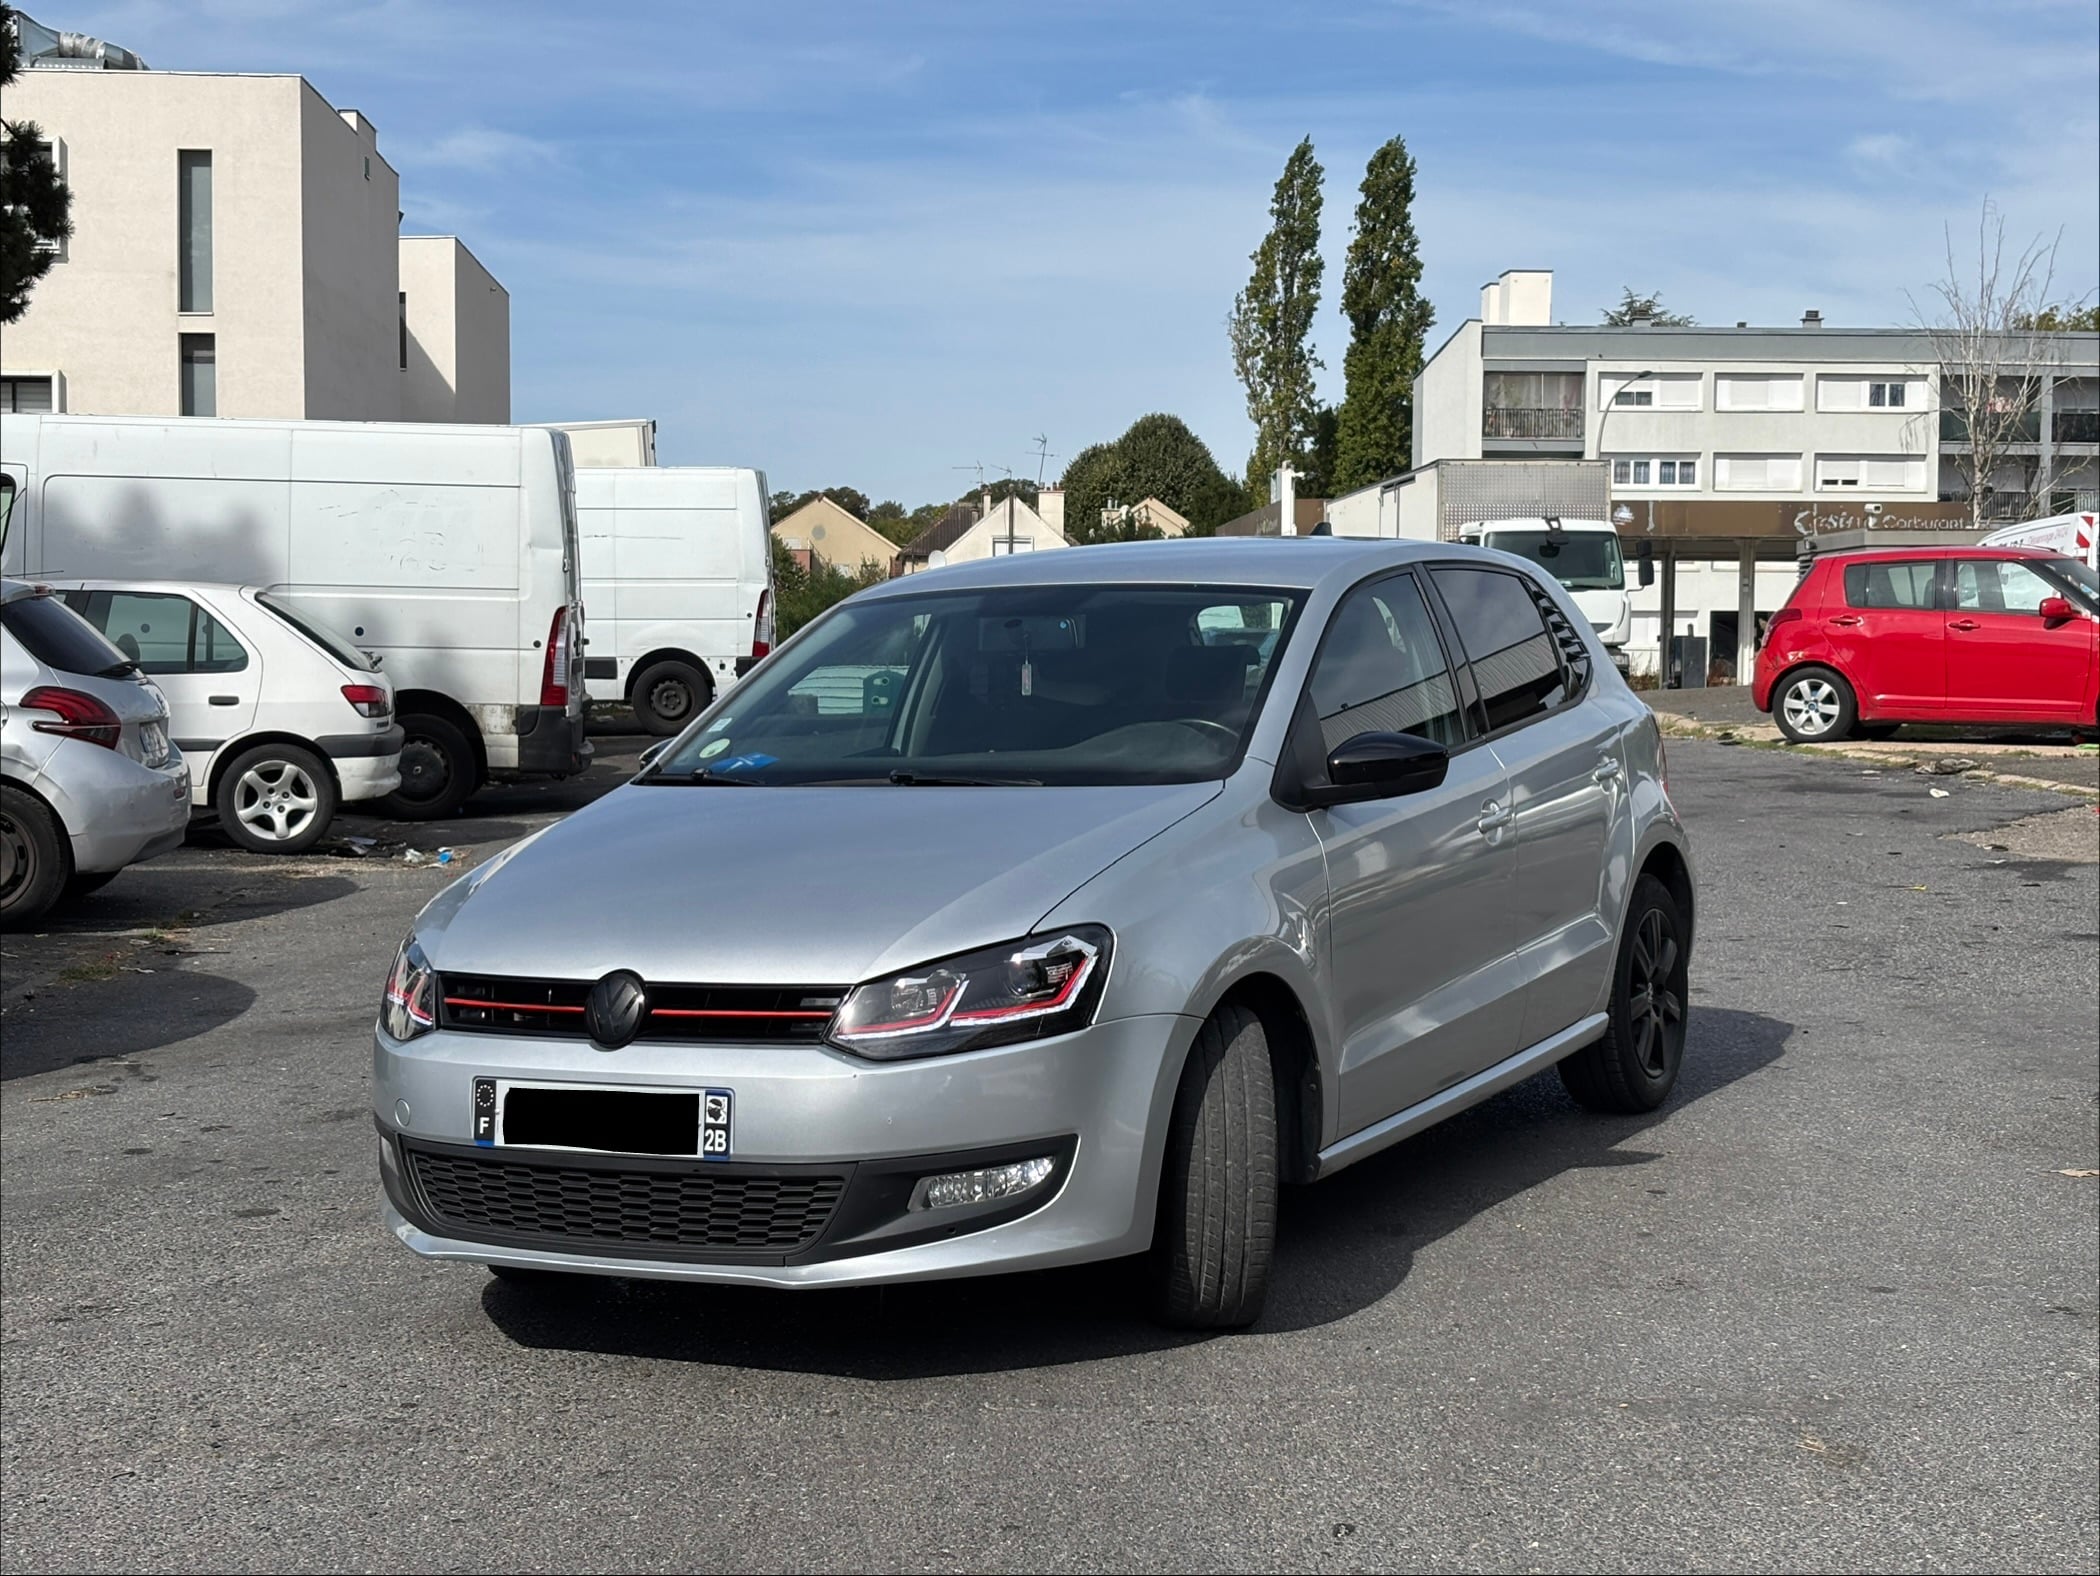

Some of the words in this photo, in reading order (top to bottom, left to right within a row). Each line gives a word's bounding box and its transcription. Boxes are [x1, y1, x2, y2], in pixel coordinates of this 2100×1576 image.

[1882, 514, 1964, 529] Carburant
[479, 1116, 490, 1135] F
[704, 1128, 727, 1152] 2B
